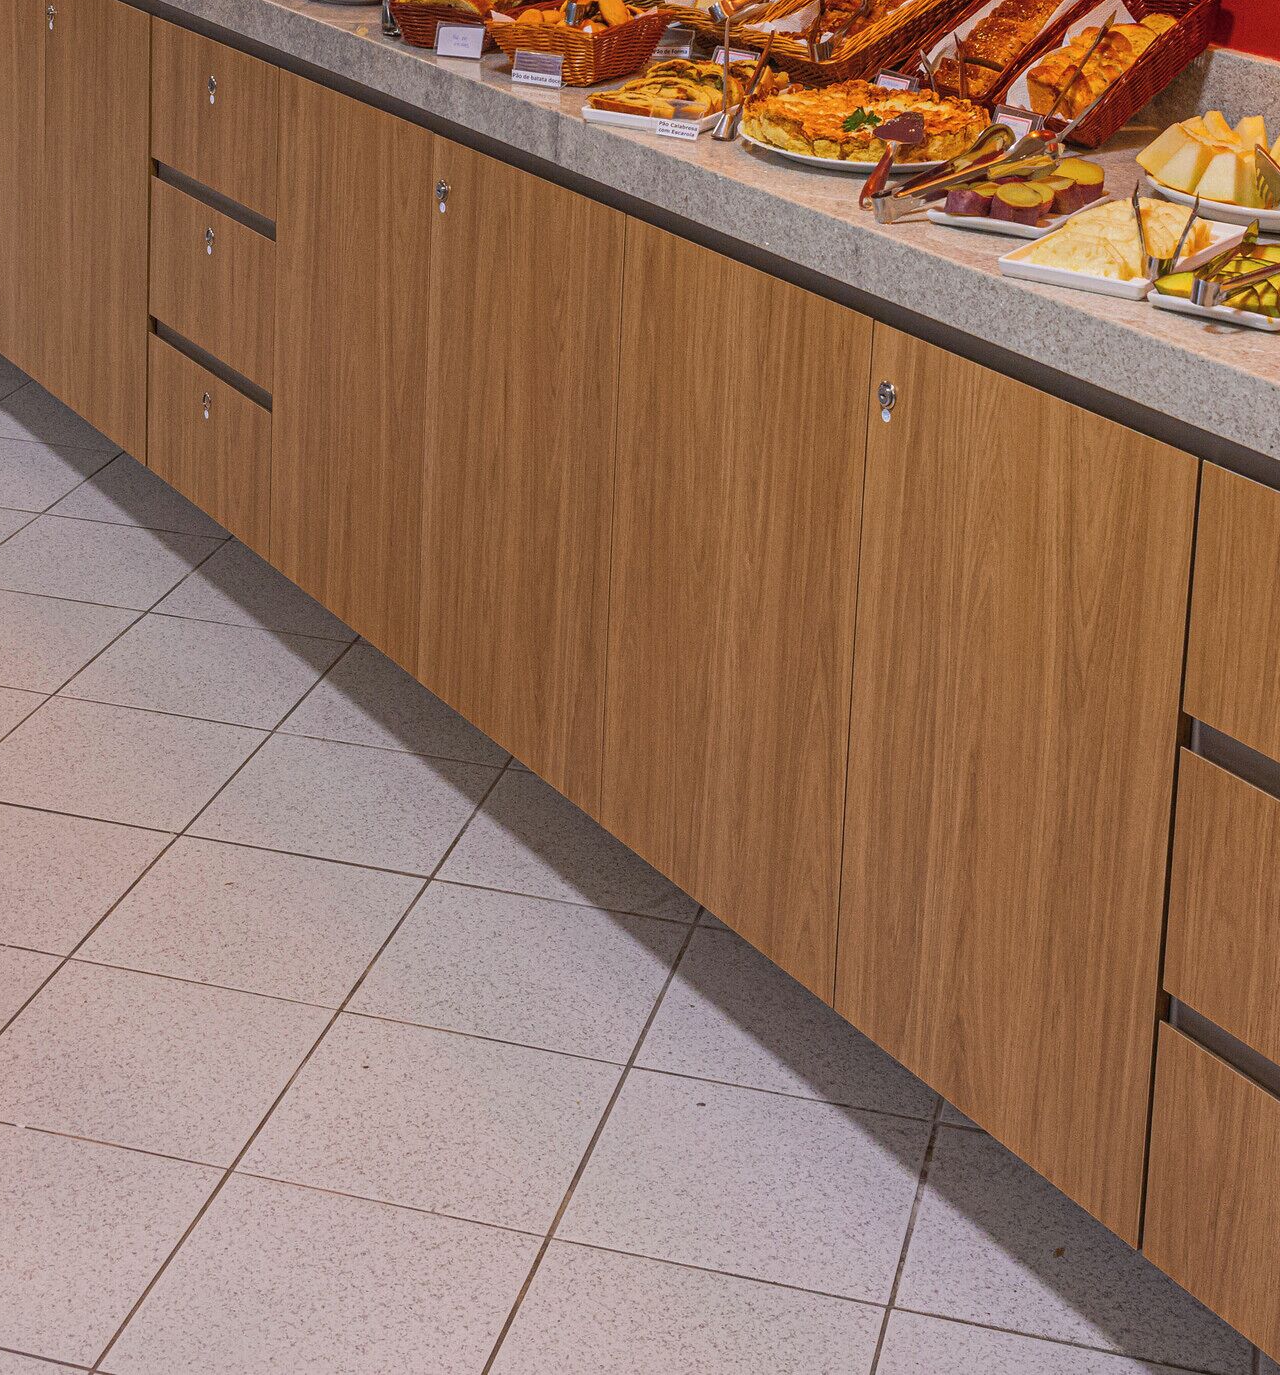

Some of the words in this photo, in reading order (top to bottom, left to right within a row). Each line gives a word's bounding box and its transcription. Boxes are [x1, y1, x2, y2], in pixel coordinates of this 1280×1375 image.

[530, 74, 547, 82] batata
[670, 122, 698, 132] Calabresa
[671, 129, 695, 137] Escarola
